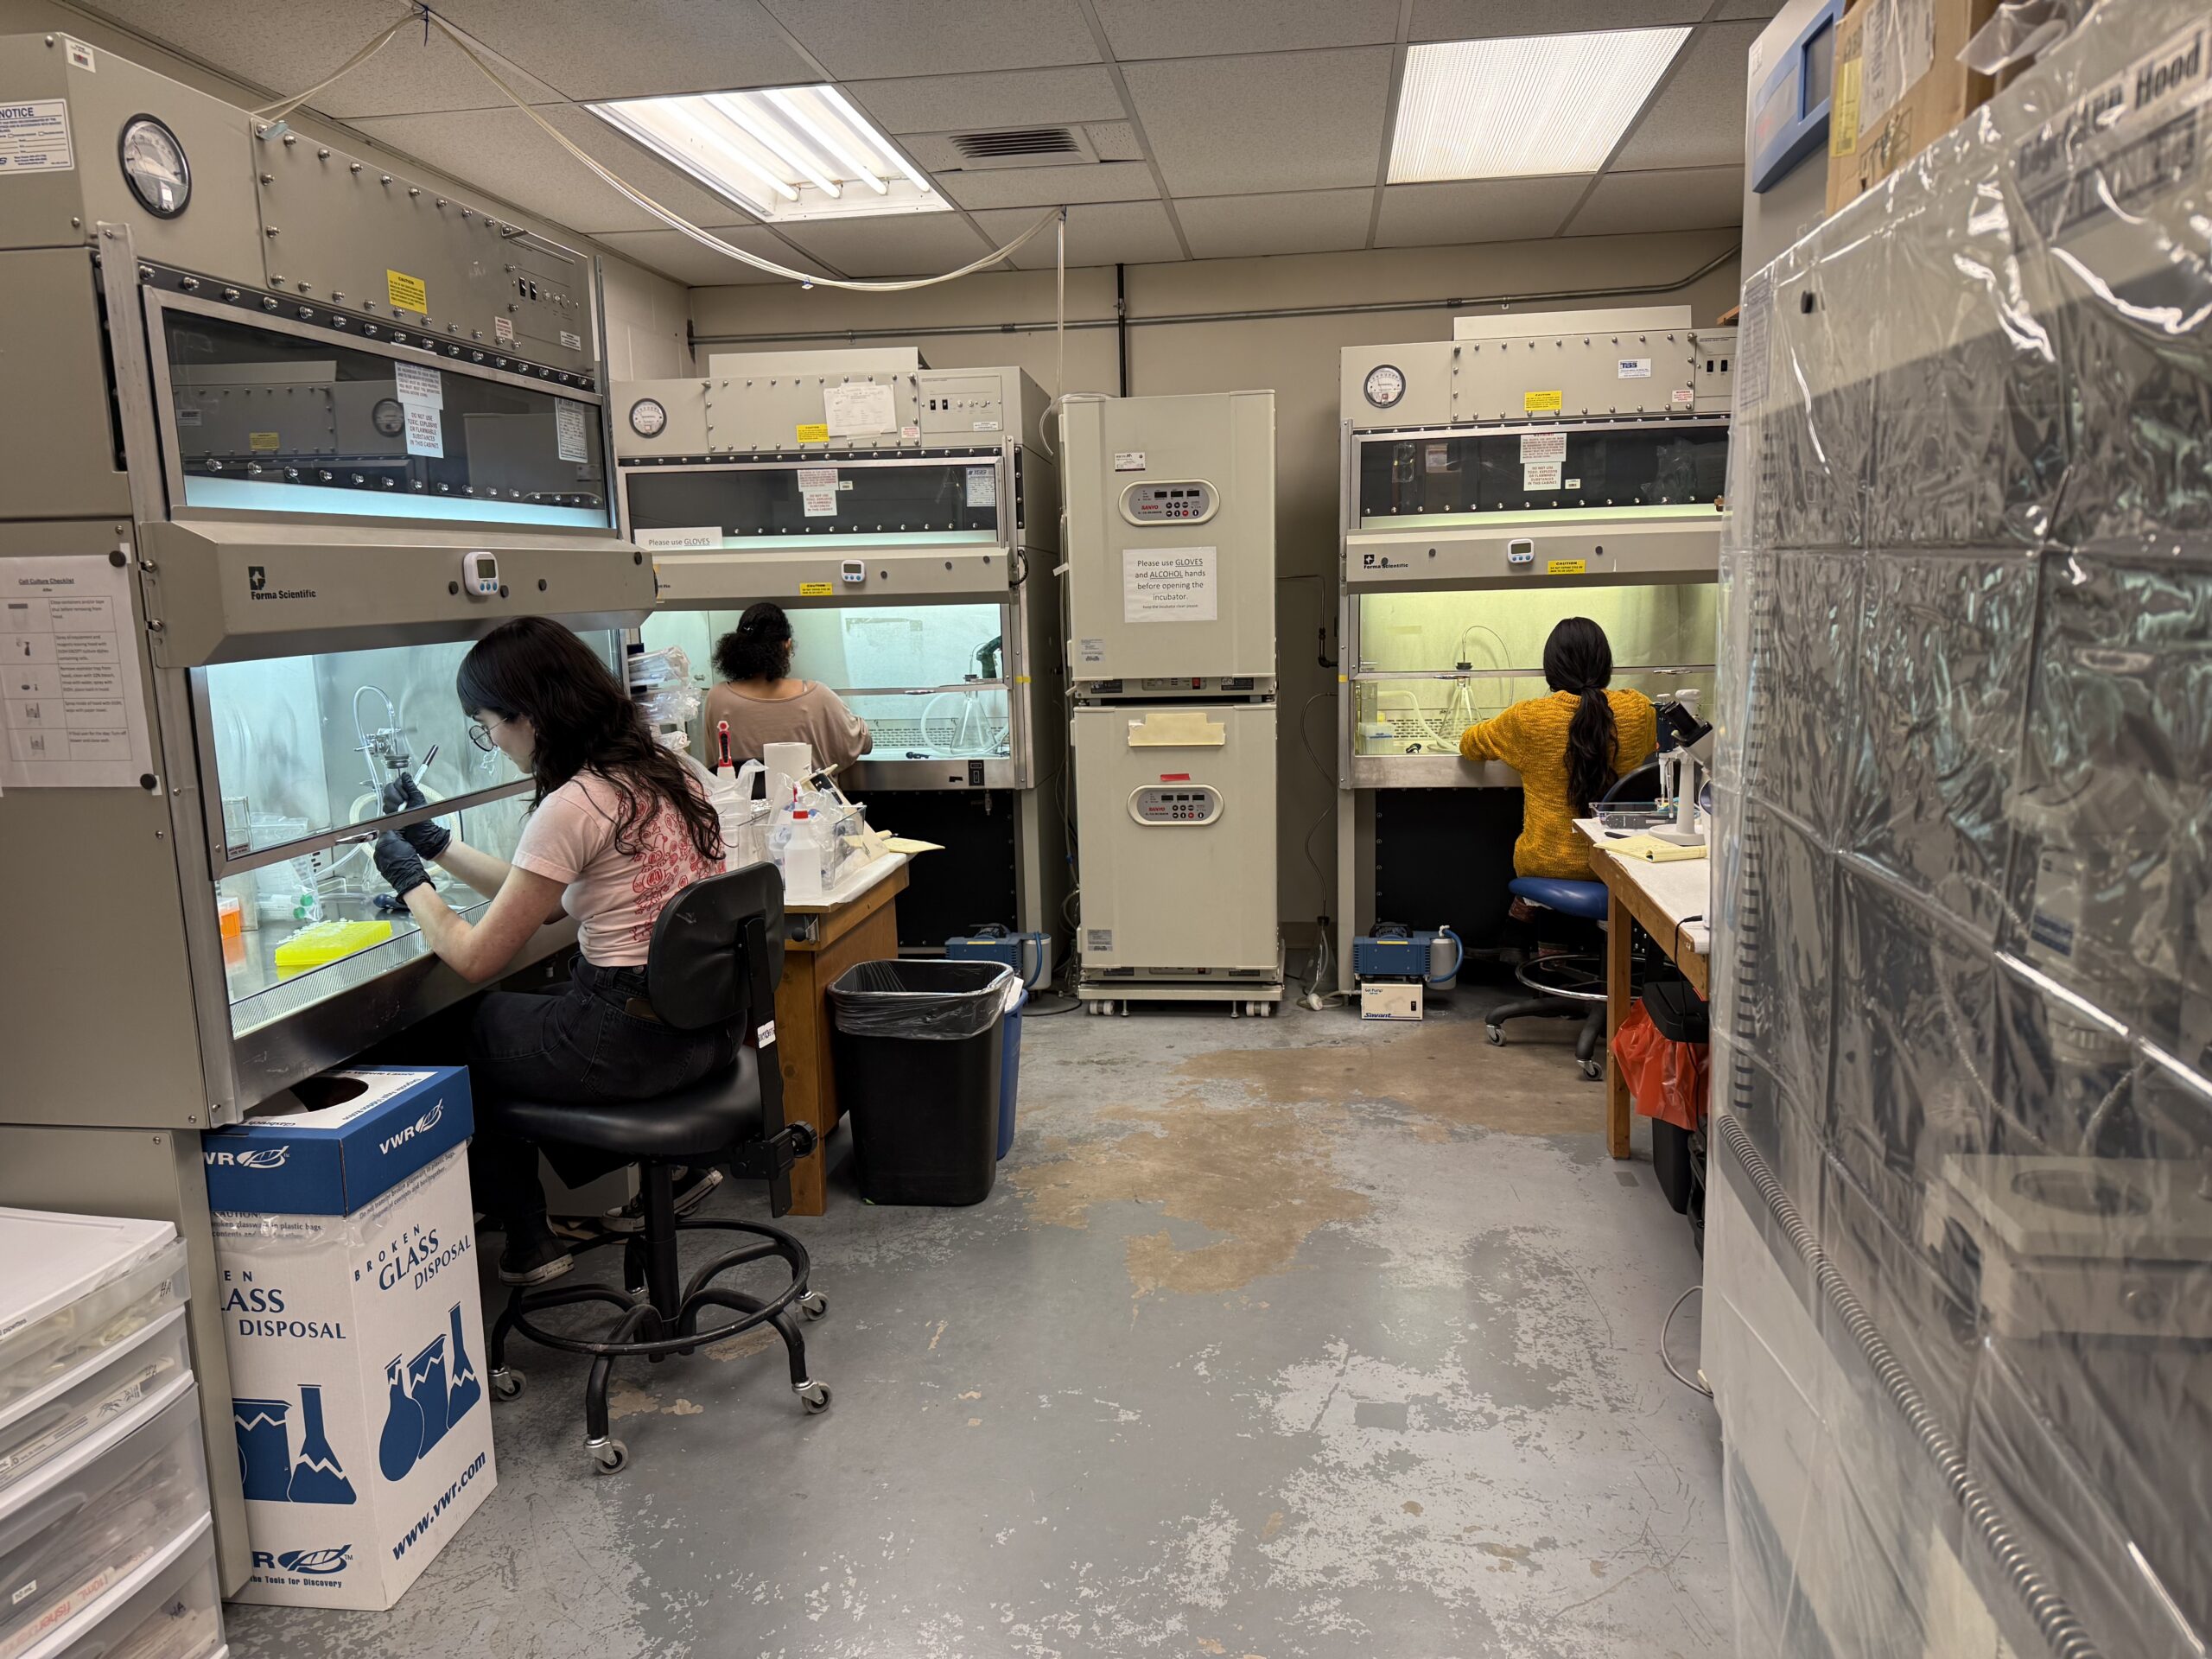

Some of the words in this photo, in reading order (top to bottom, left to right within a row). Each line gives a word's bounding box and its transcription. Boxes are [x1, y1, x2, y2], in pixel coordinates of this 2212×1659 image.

[2135, 29, 2203, 111] Hood
[0, 107, 34, 118] NOTICE
[1175, 558, 1203, 567] GLOVES
[251, 591, 277, 600] Forma
[278, 589, 316, 599] Scientific
[379, 1125, 416, 1155] VWR
[203, 1151, 234, 1166] WR
[280, 1222, 302, 1230] plastic
[354, 1224, 420, 1281] BROKEN
[379, 1229, 439, 1290] GLASS
[414, 1235, 471, 1290] DISPOSAL
[239, 1319, 346, 1340] DISPOSAL
[392, 1452, 486, 1560] www.vwr.com
[265, 1576, 284, 1585] Tools
[289, 1577, 300, 1586] for
[303, 1579, 341, 1588] Discovery
